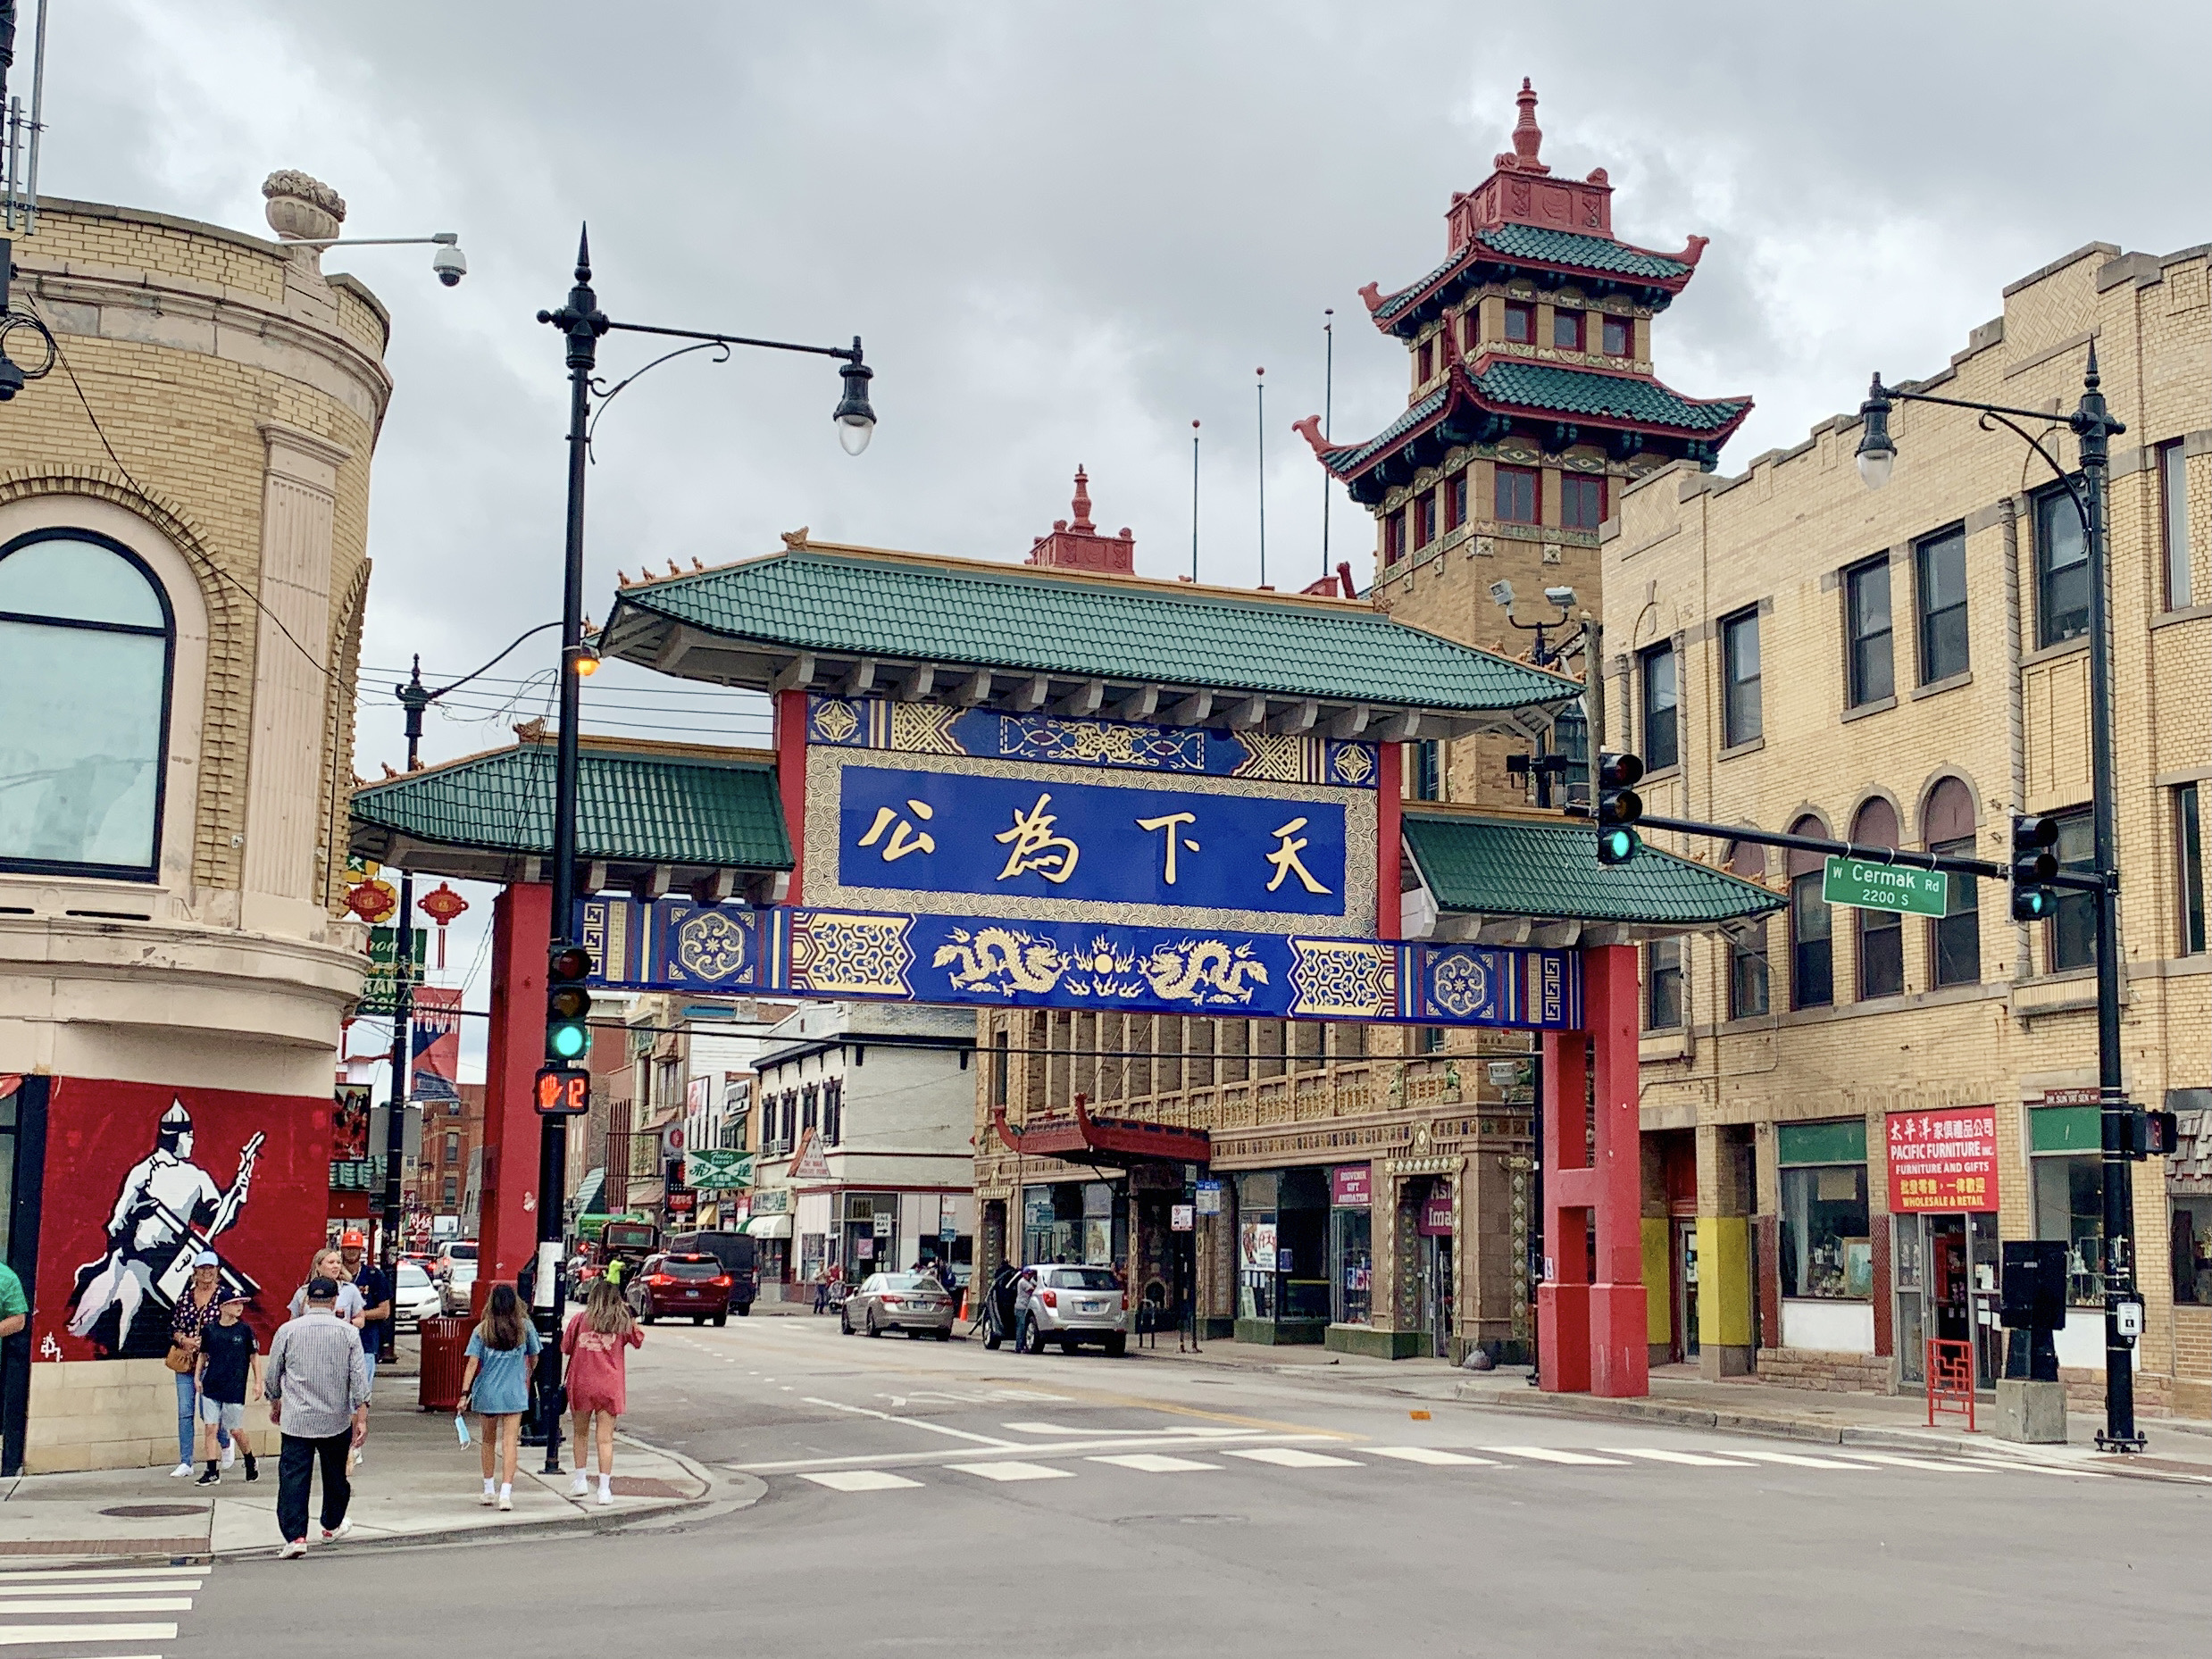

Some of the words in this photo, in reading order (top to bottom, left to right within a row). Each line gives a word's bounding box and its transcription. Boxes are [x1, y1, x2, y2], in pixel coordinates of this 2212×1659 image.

[1832, 866, 1842, 879] W
[1852, 863, 1916, 888] Cermak
[1924, 879, 1940, 892] Rd
[1862, 888, 1895, 905] 2200
[1901, 894, 1909, 906] S
[415, 1017, 459, 1035] TOWN
[567, 1078, 585, 1108] 12
[1891, 1144, 1925, 1160] PACIFIC
[1926, 1140, 1981, 1158] FURNITURE
[1896, 1163, 1942, 1175] FURNITURE
[1943, 1163, 1962, 1173] AND
[1964, 1162, 1989, 1172] GIFTS
[1902, 1196, 1948, 1207] WHOLESALE
[1949, 1196, 1956, 1206] &
[1957, 1196, 1984, 1206] RETAIL
